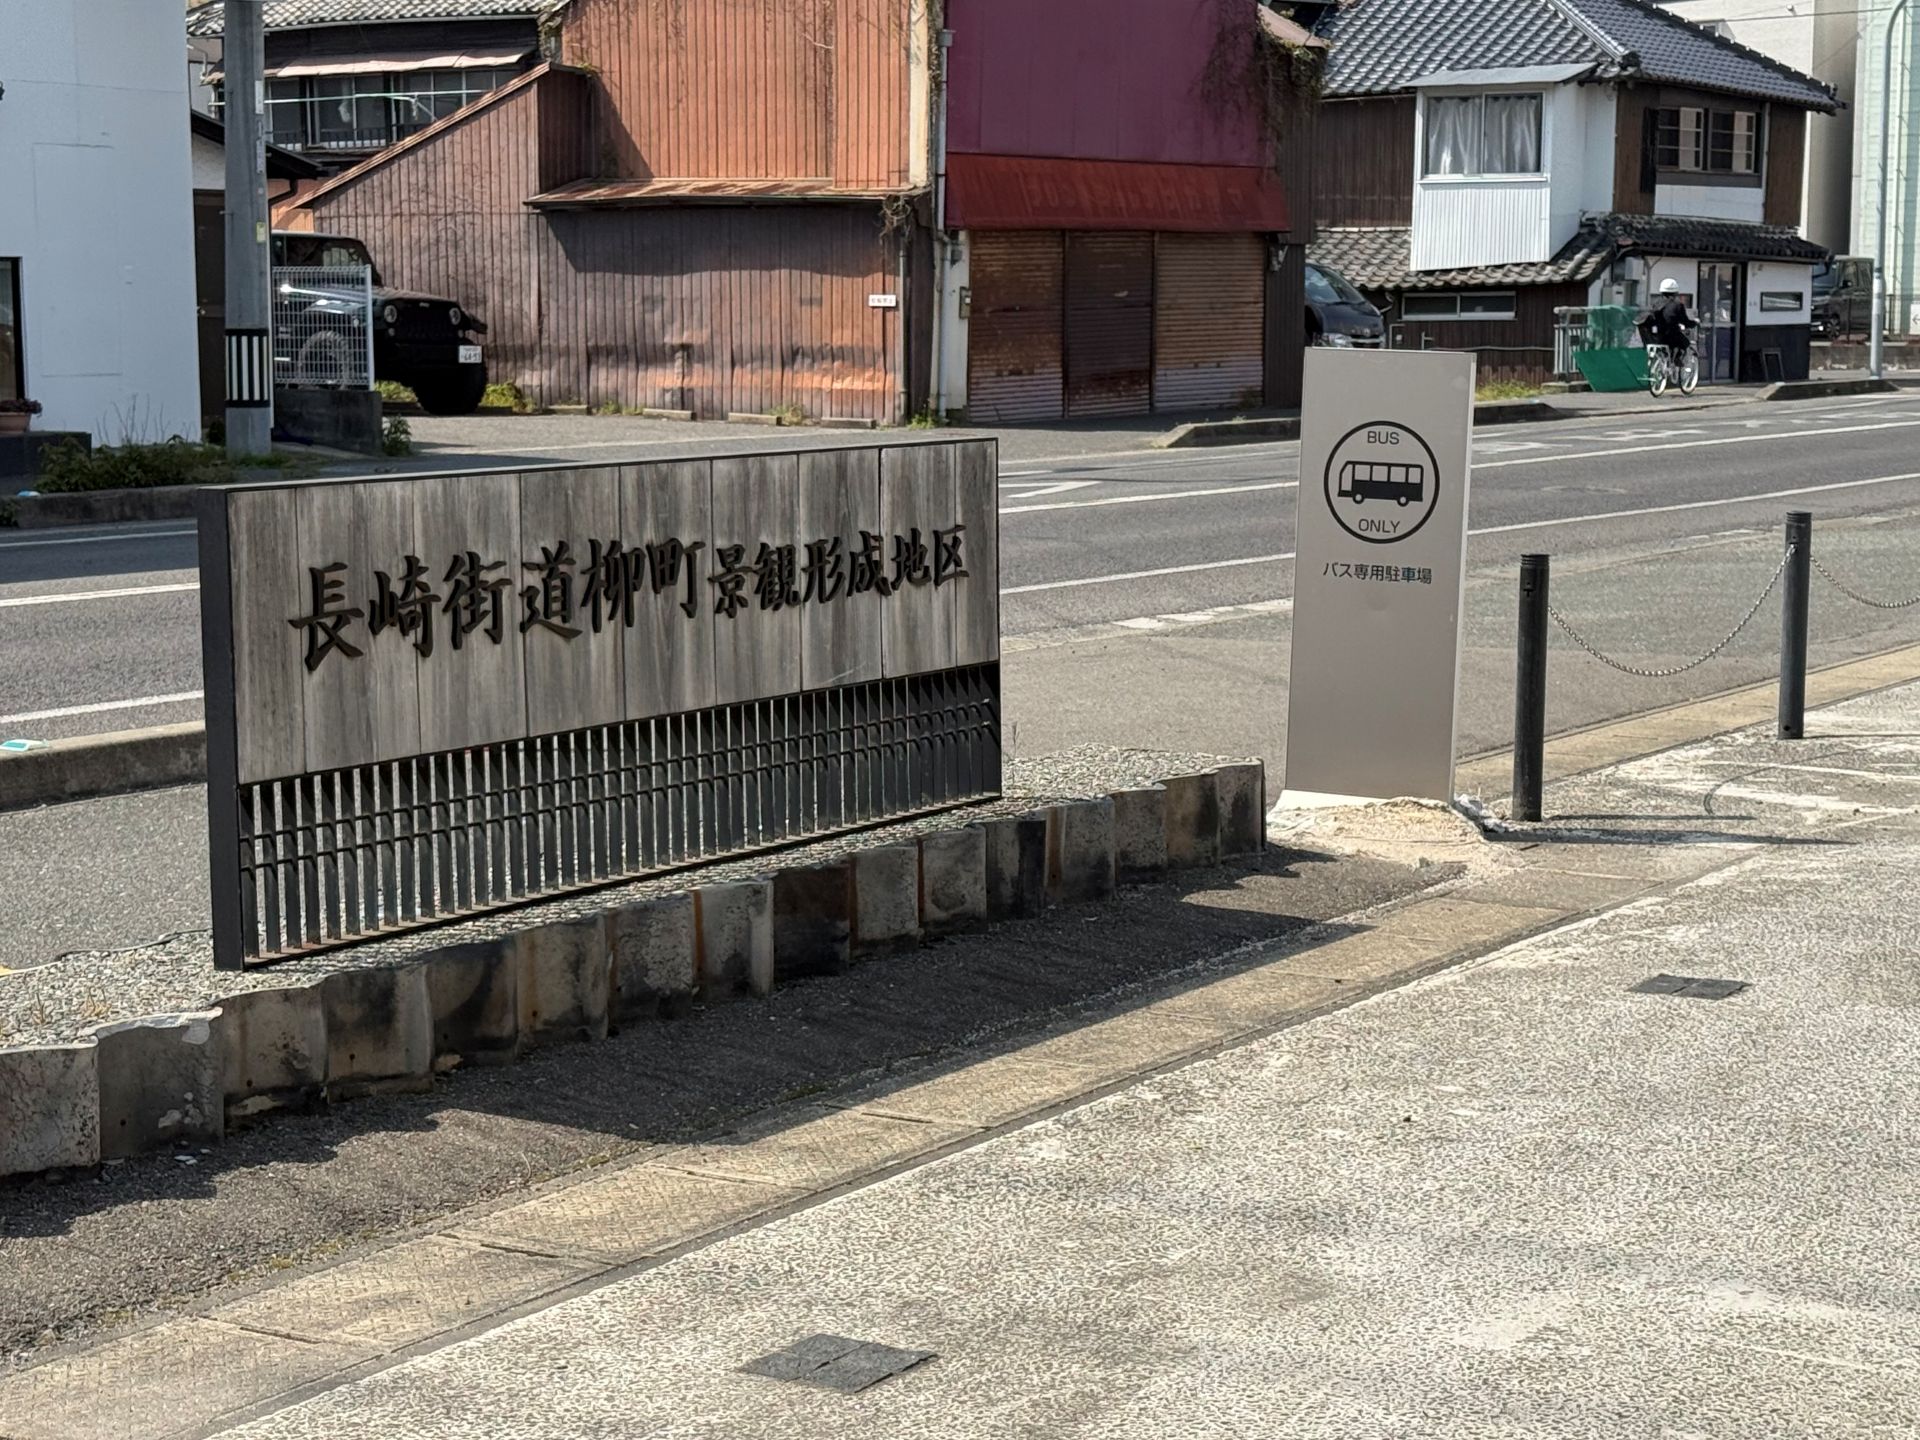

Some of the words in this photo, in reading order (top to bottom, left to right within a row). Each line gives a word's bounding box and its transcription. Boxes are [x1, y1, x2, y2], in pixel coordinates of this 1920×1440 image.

[1367, 431, 1399, 444] BUS
[1358, 518, 1400, 533] ONLY
[1323, 562, 1432, 584] バス専用駐車場
[288, 524, 971, 672] 長崎街道柳町景観形成地区
